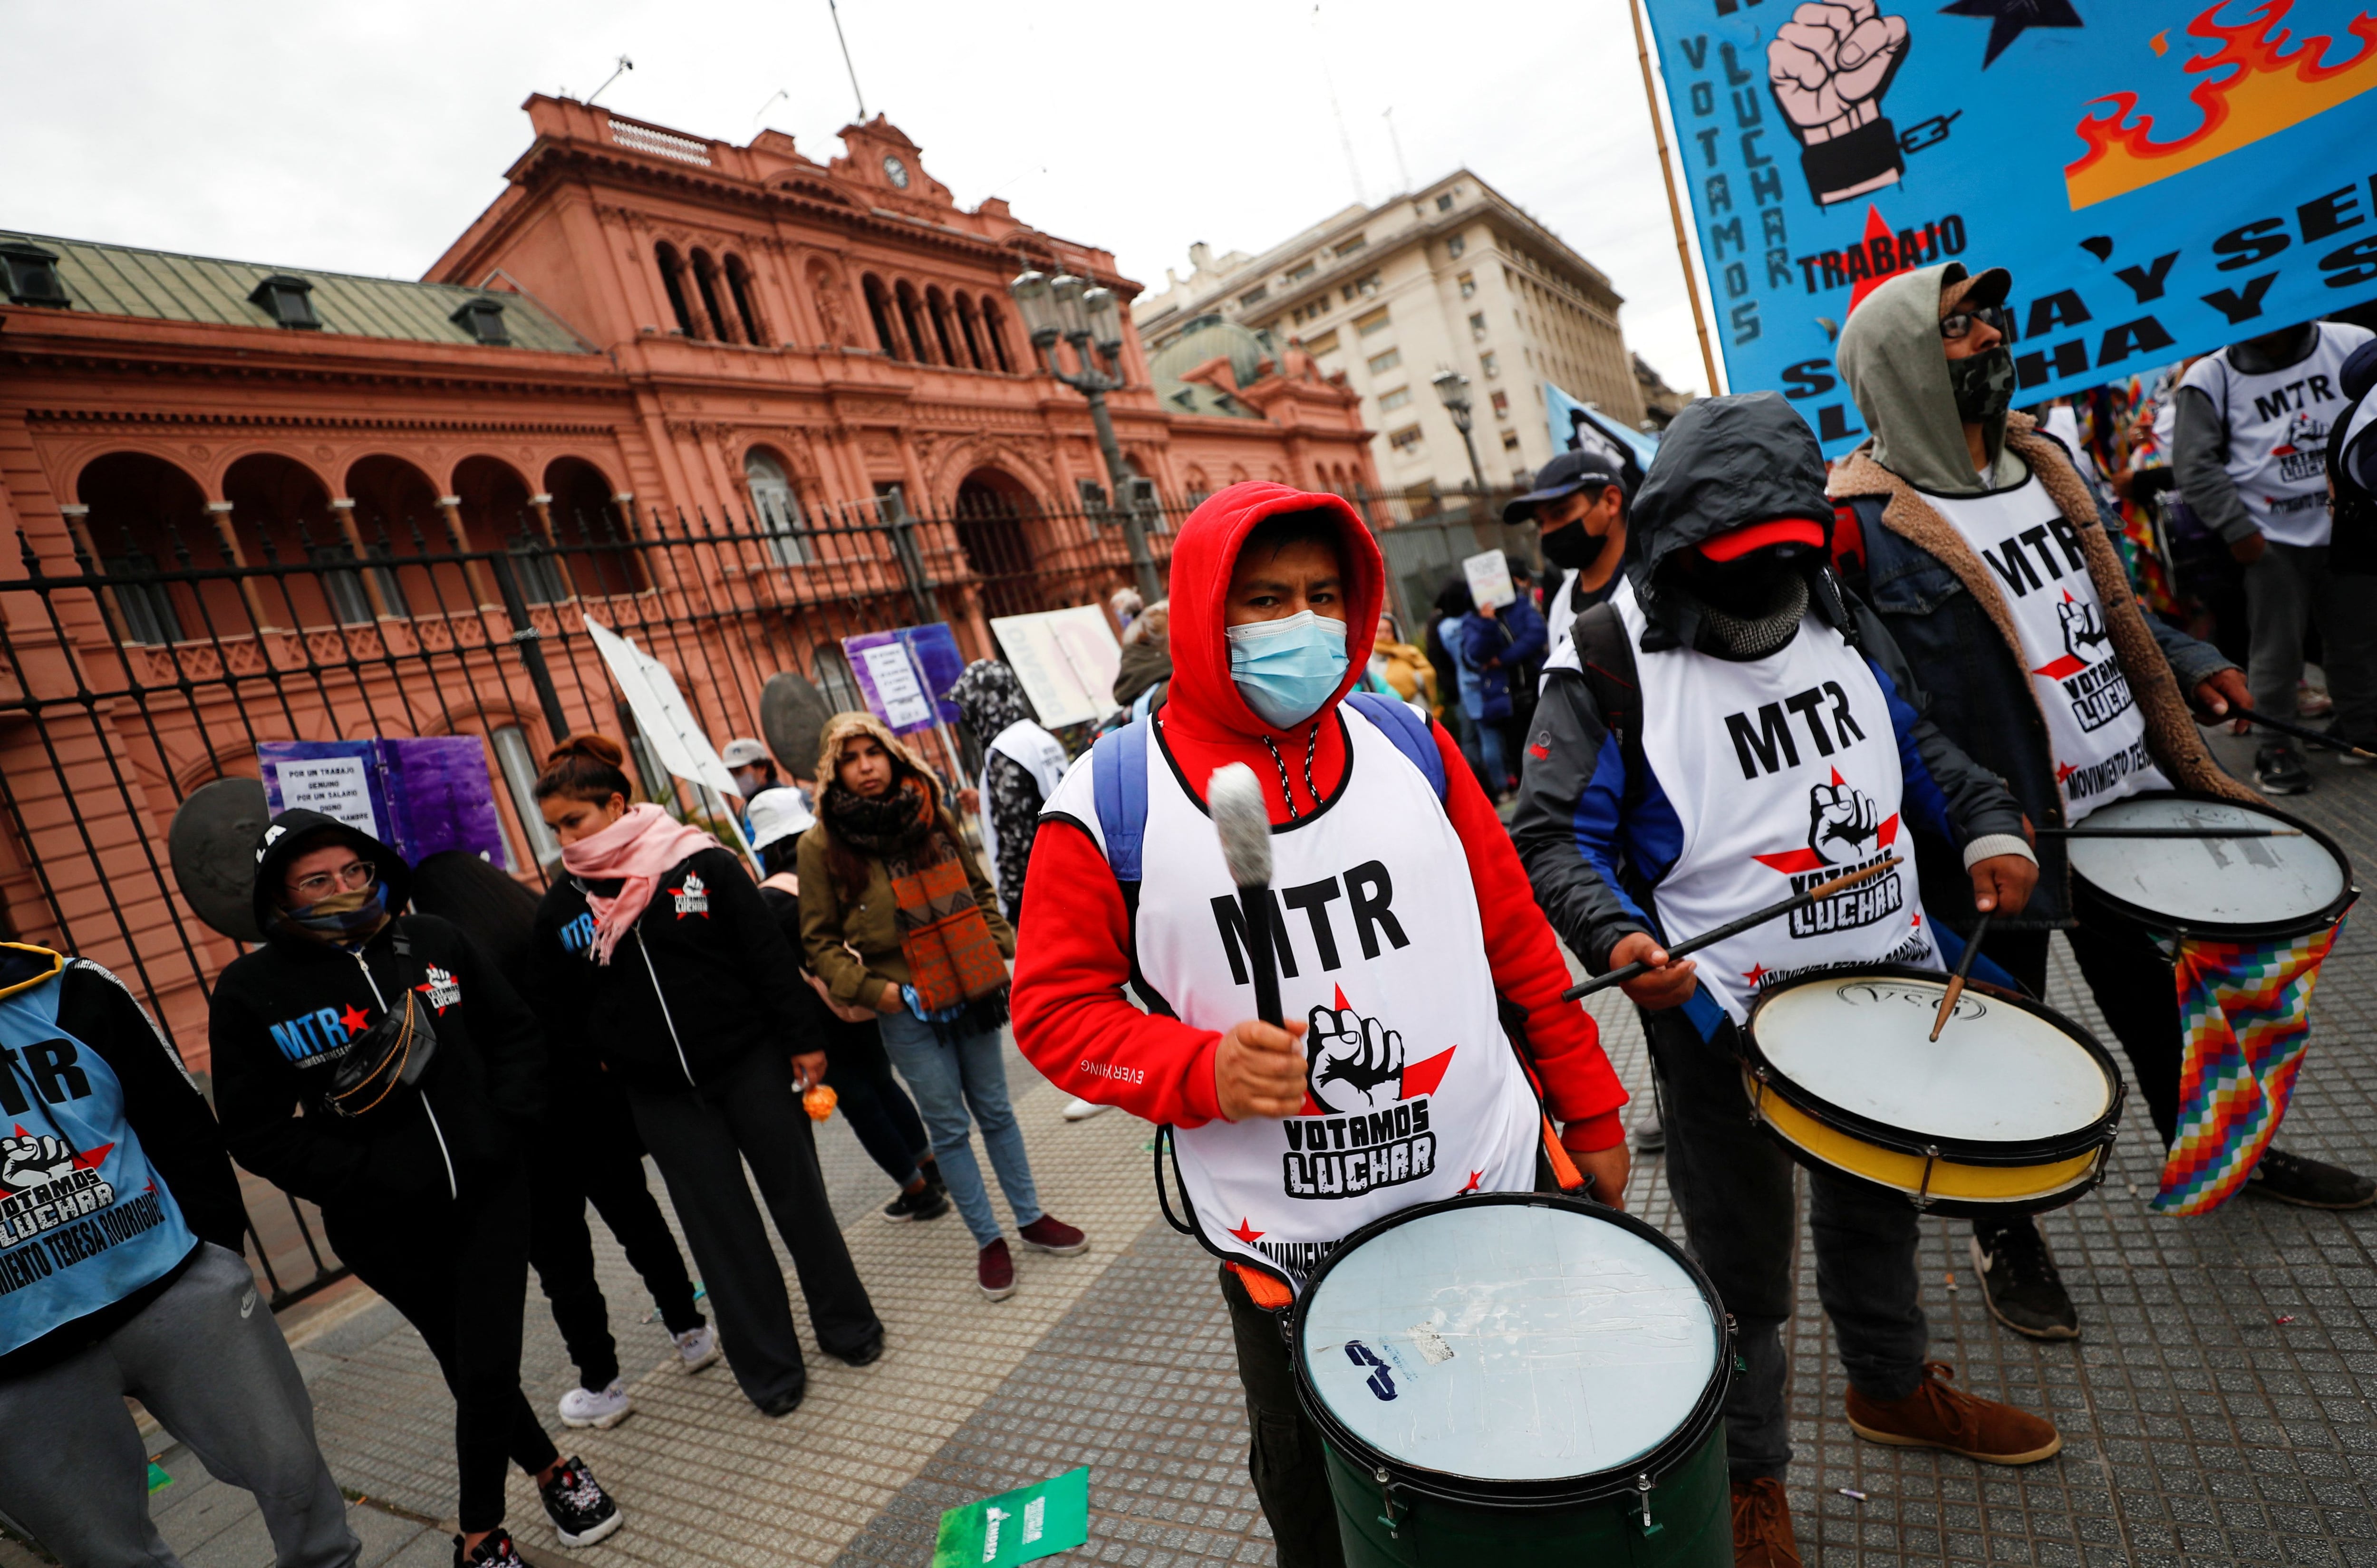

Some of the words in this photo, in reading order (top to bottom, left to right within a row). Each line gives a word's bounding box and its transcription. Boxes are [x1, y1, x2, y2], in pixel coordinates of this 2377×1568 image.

[1680, 34, 1761, 346] VOTAMOS
[1719, 42, 1793, 289] LUCHAR
[1796, 214, 1967, 294] TRABAJO
[2212, 174, 2377, 272] SE
[2005, 250, 2181, 343] AY
[2016, 270, 2280, 390] HAY
[2254, 375, 2335, 422] MTR
[1982, 517, 2086, 598] MTR
[1724, 681, 1866, 780] MTR
[321, 767, 355, 776] TRABAJO
[328, 790, 358, 799] SALARIO
[1210, 860, 1410, 986] MTR
[1792, 875, 1901, 936] LUCHAR
[270, 1007, 349, 1062] MTR
[1283, 1099, 1429, 1151] VOTAMOS
[0, 1168, 102, 1222] OTAMOS
[1288, 1136, 1432, 1196] LUCHAR
[0, 1183, 114, 1248] LUCHAR
[42, 1219, 108, 1270] TERESA
